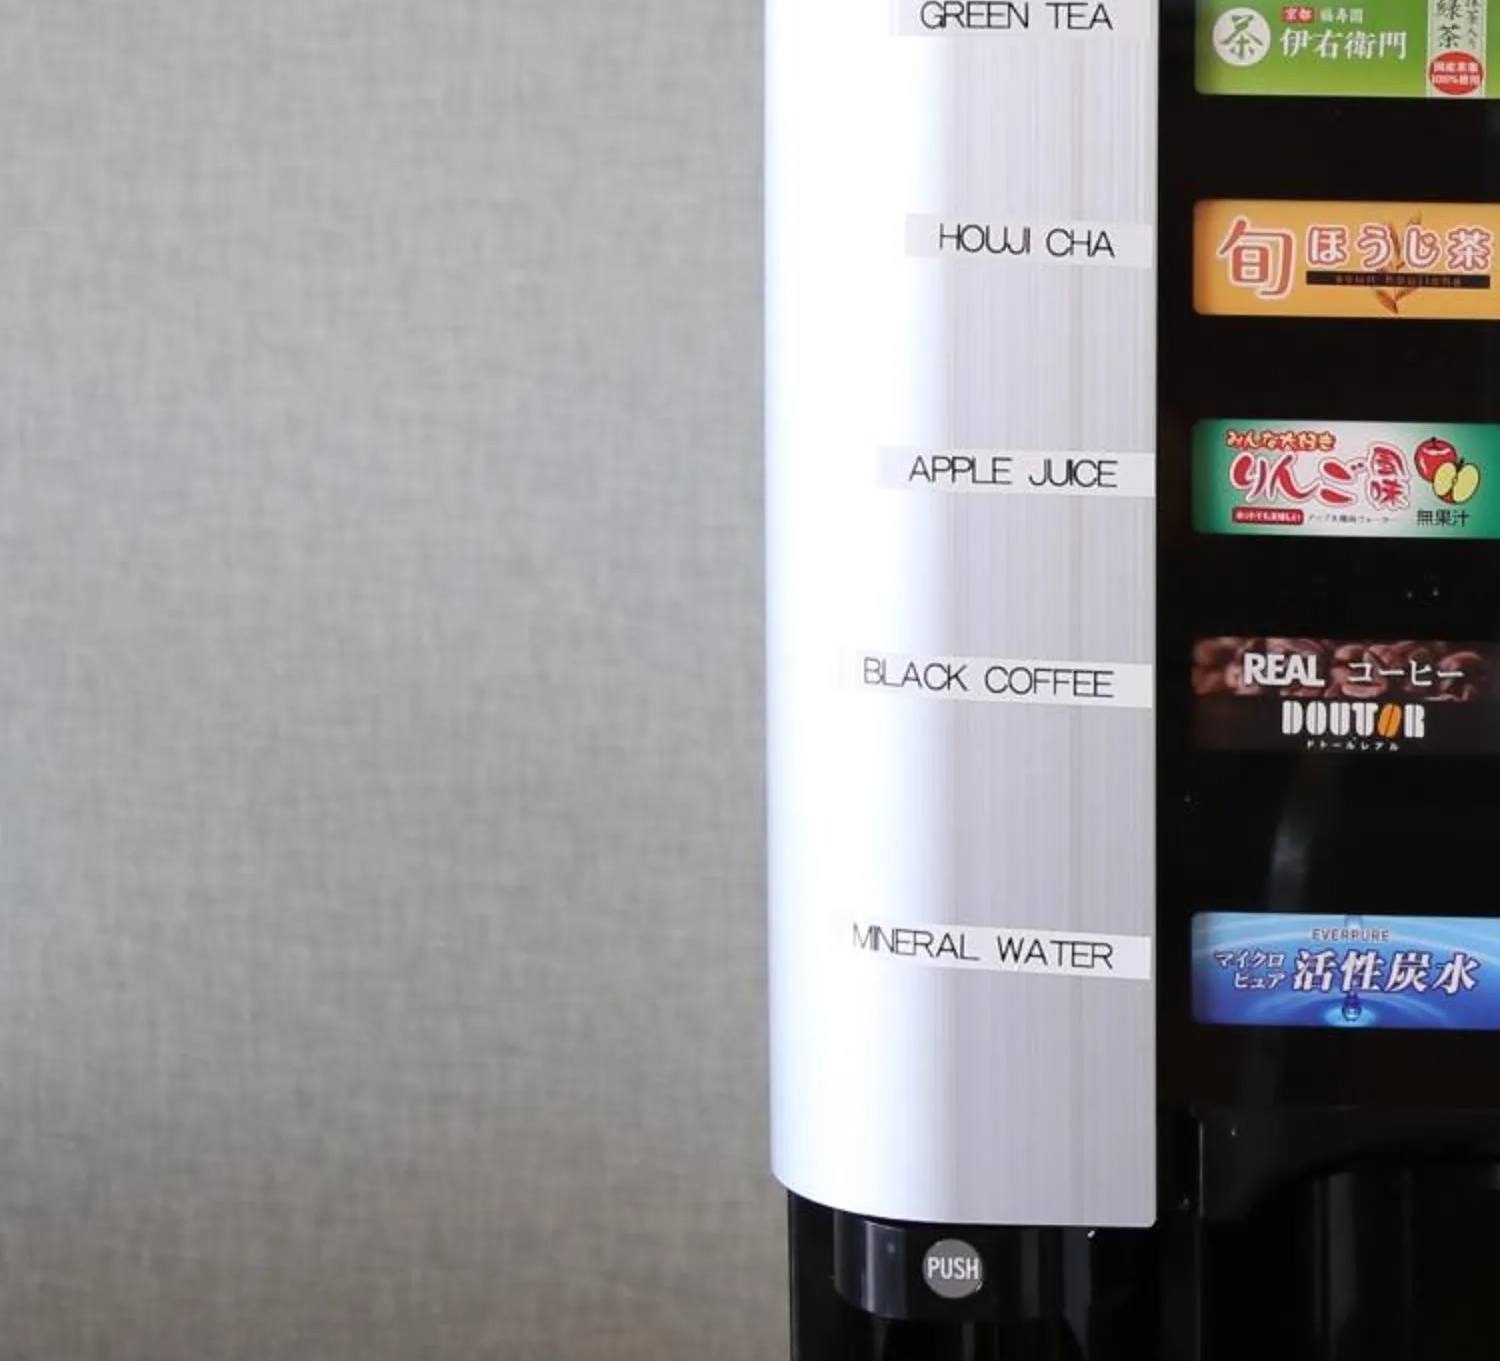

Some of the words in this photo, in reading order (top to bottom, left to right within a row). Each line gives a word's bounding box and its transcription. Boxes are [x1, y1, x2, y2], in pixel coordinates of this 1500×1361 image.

[920, 0, 1029, 30] GREEN
[1045, 2, 1113, 30] TEA
[1437, 0, 1463, 48] 緑茶
[1220, 14, 1263, 59] 茶
[1280, 27, 1407, 60] 伊右衛門
[939, 223, 1030, 255] HOUJI
[1046, 228, 1115, 258] CHA
[909, 455, 1012, 484] APPLE
[1029, 458, 1118, 488] JUICE
[1416, 509, 1470, 527] 無果汁
[863, 657, 968, 691] BLACK
[984, 666, 1115, 698] COFFEE
[1243, 652, 1326, 687] REAL
[1347, 660, 1465, 687] コーヒー
[1282, 700, 1425, 738] DOUTOR
[852, 922, 980, 961] MINERAL
[997, 935, 1113, 969] WATER
[1312, 928, 1389, 942] EVERPURE
[1214, 950, 1286, 968] マイクロ
[1293, 949, 1482, 994] 活性炭水
[927, 1256, 979, 1281] PUSH
